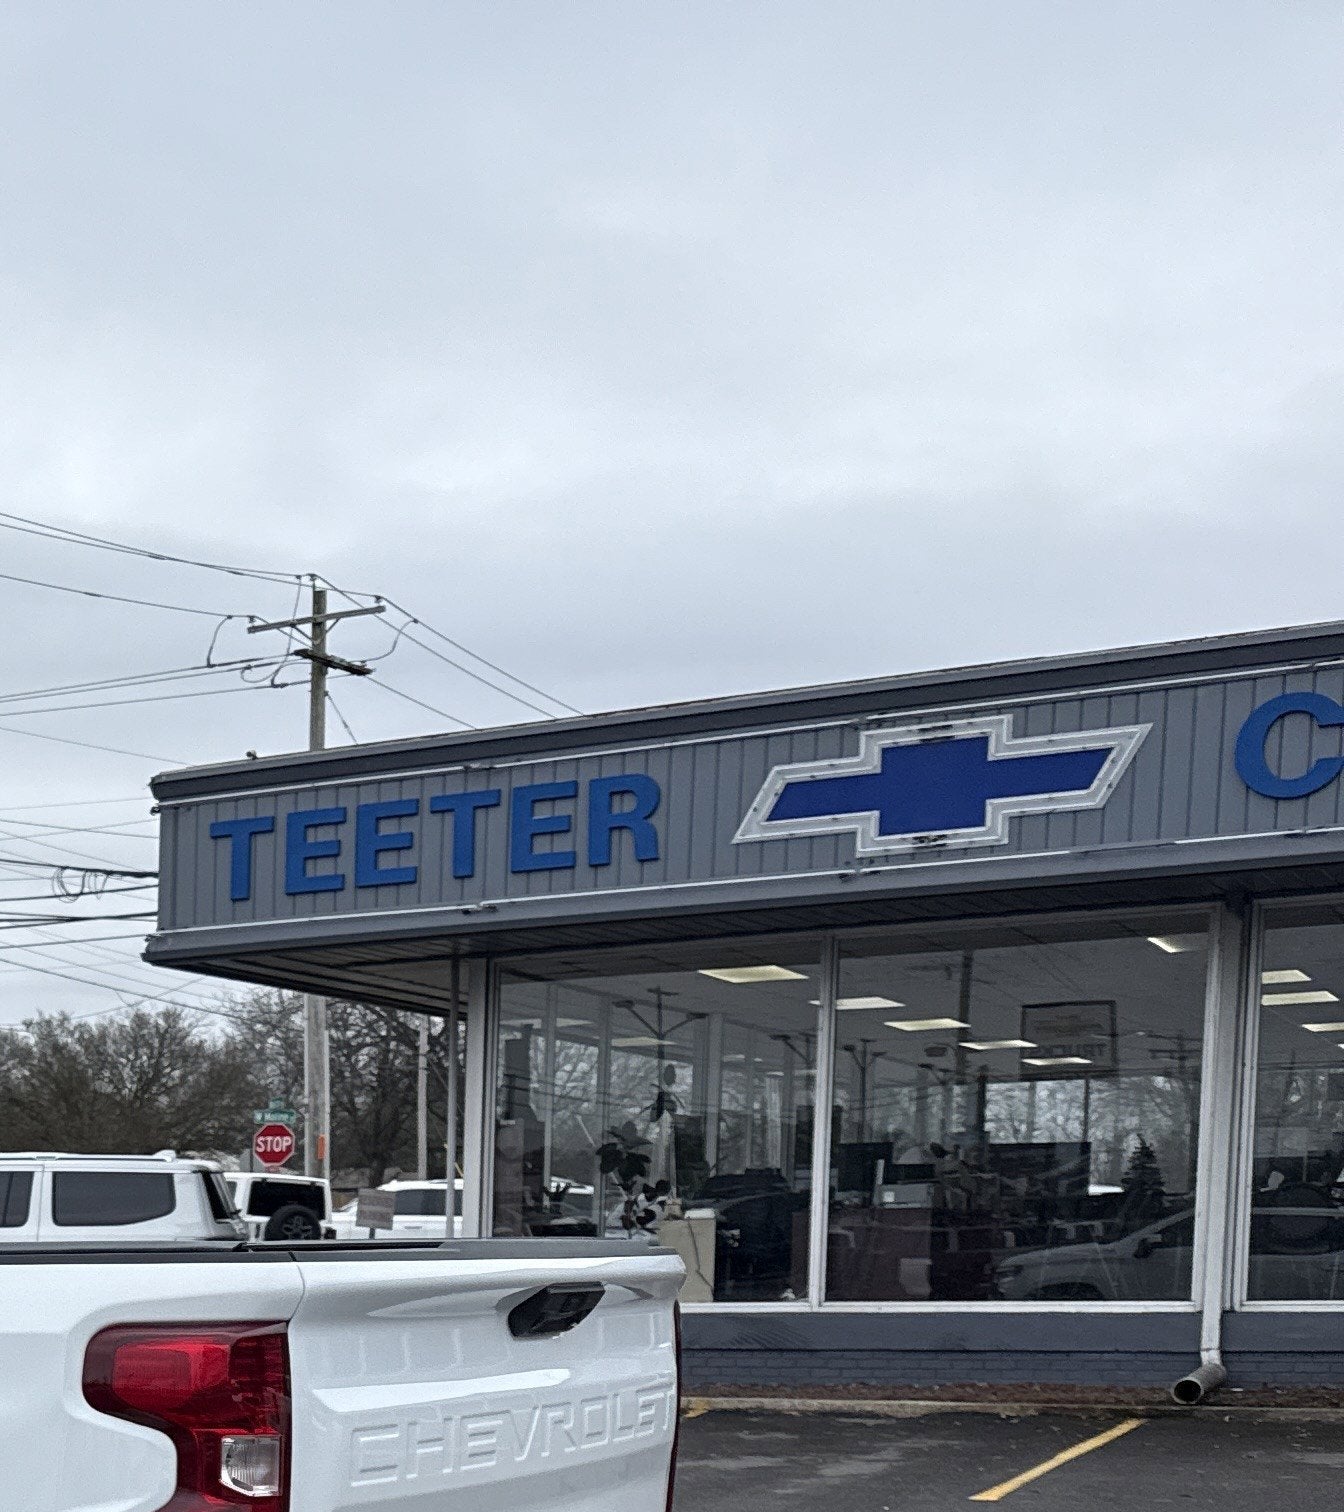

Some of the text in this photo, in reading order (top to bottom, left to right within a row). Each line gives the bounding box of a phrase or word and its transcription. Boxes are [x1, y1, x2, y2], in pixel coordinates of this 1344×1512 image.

[210, 773, 661, 901] TEETER
[256, 1136, 292, 1153] STOP
[349, 1371, 674, 1487] CHEVROLET
